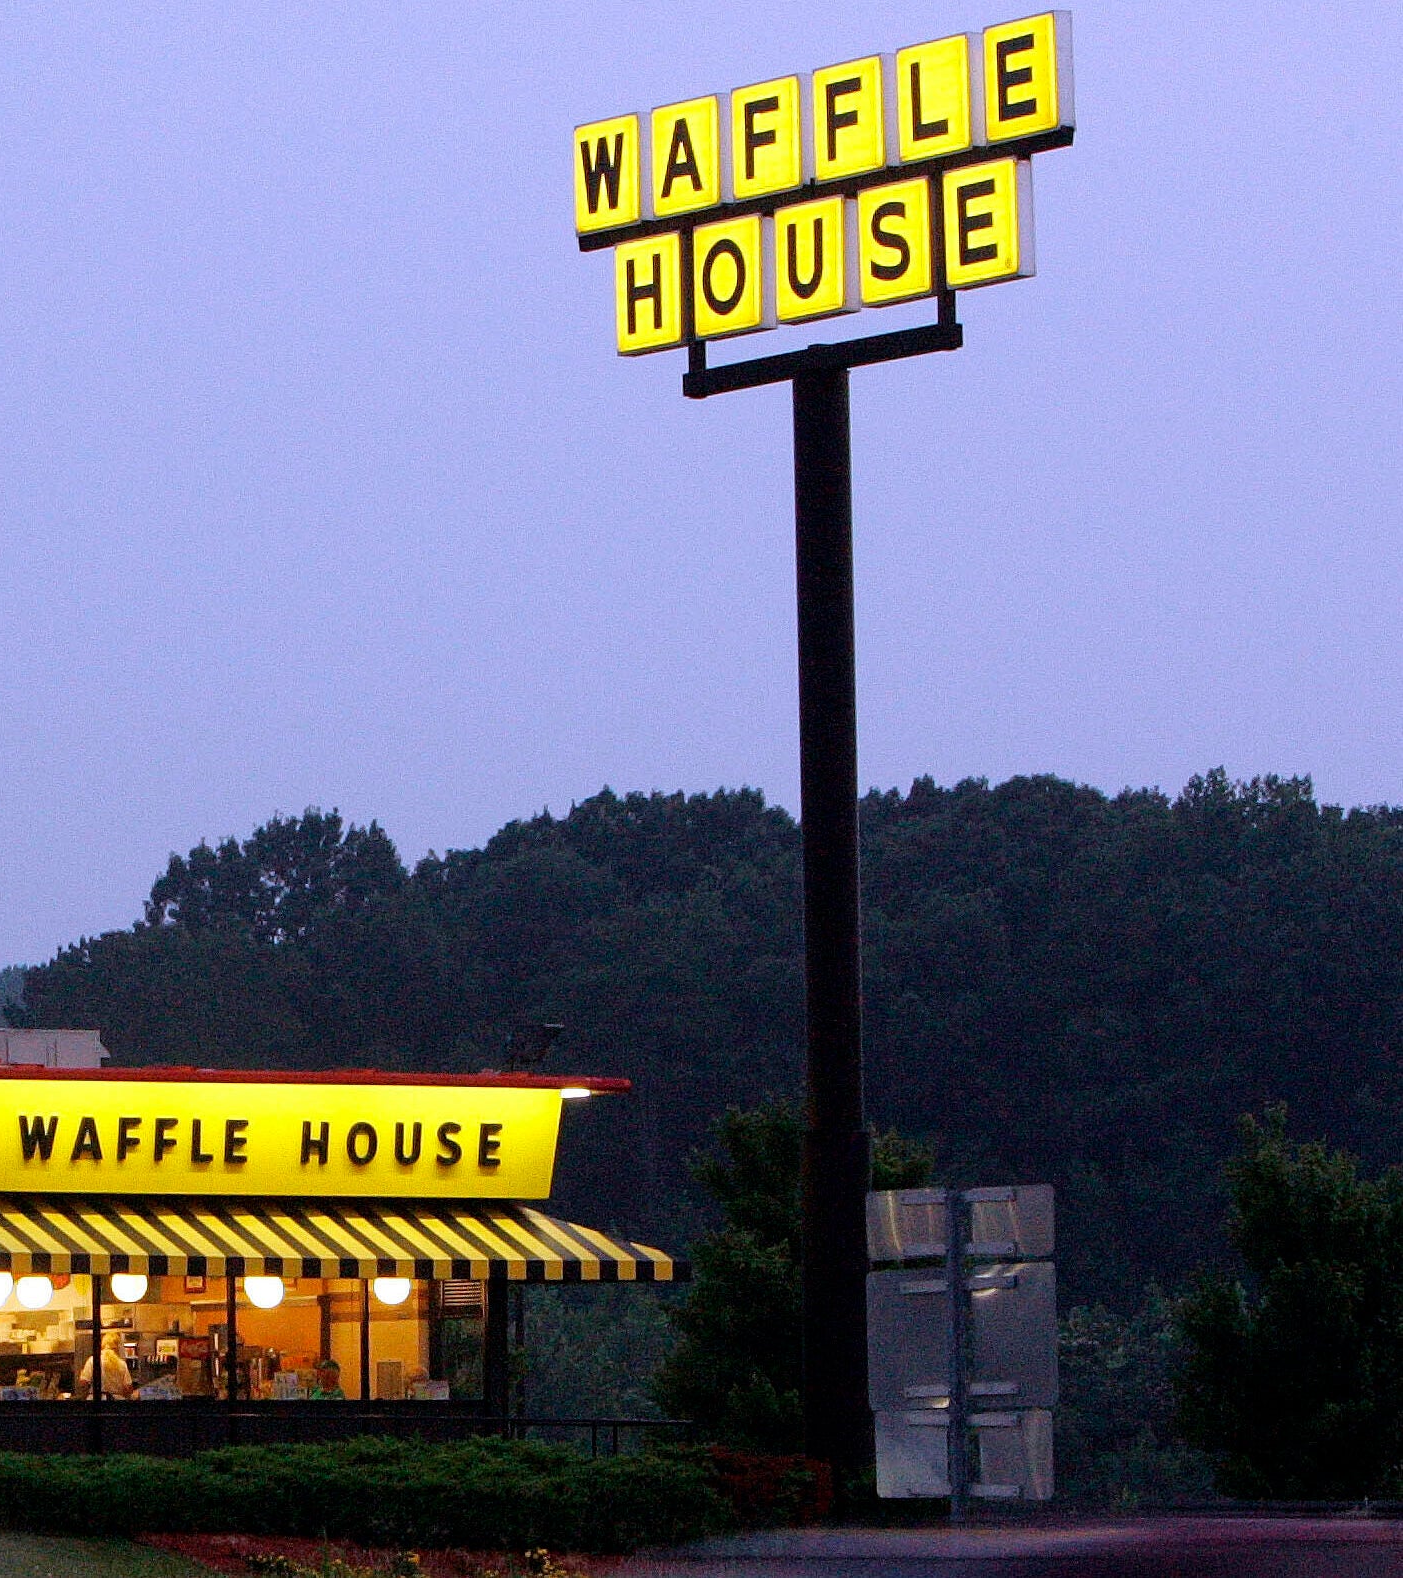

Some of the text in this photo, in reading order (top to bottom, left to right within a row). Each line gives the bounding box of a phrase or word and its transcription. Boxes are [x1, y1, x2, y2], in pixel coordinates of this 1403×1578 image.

[580, 33, 1038, 214] WAFFLE
[625, 178, 998, 335] HOUSE
[18, 1115, 503, 1167] WAFFLE HOUSE
